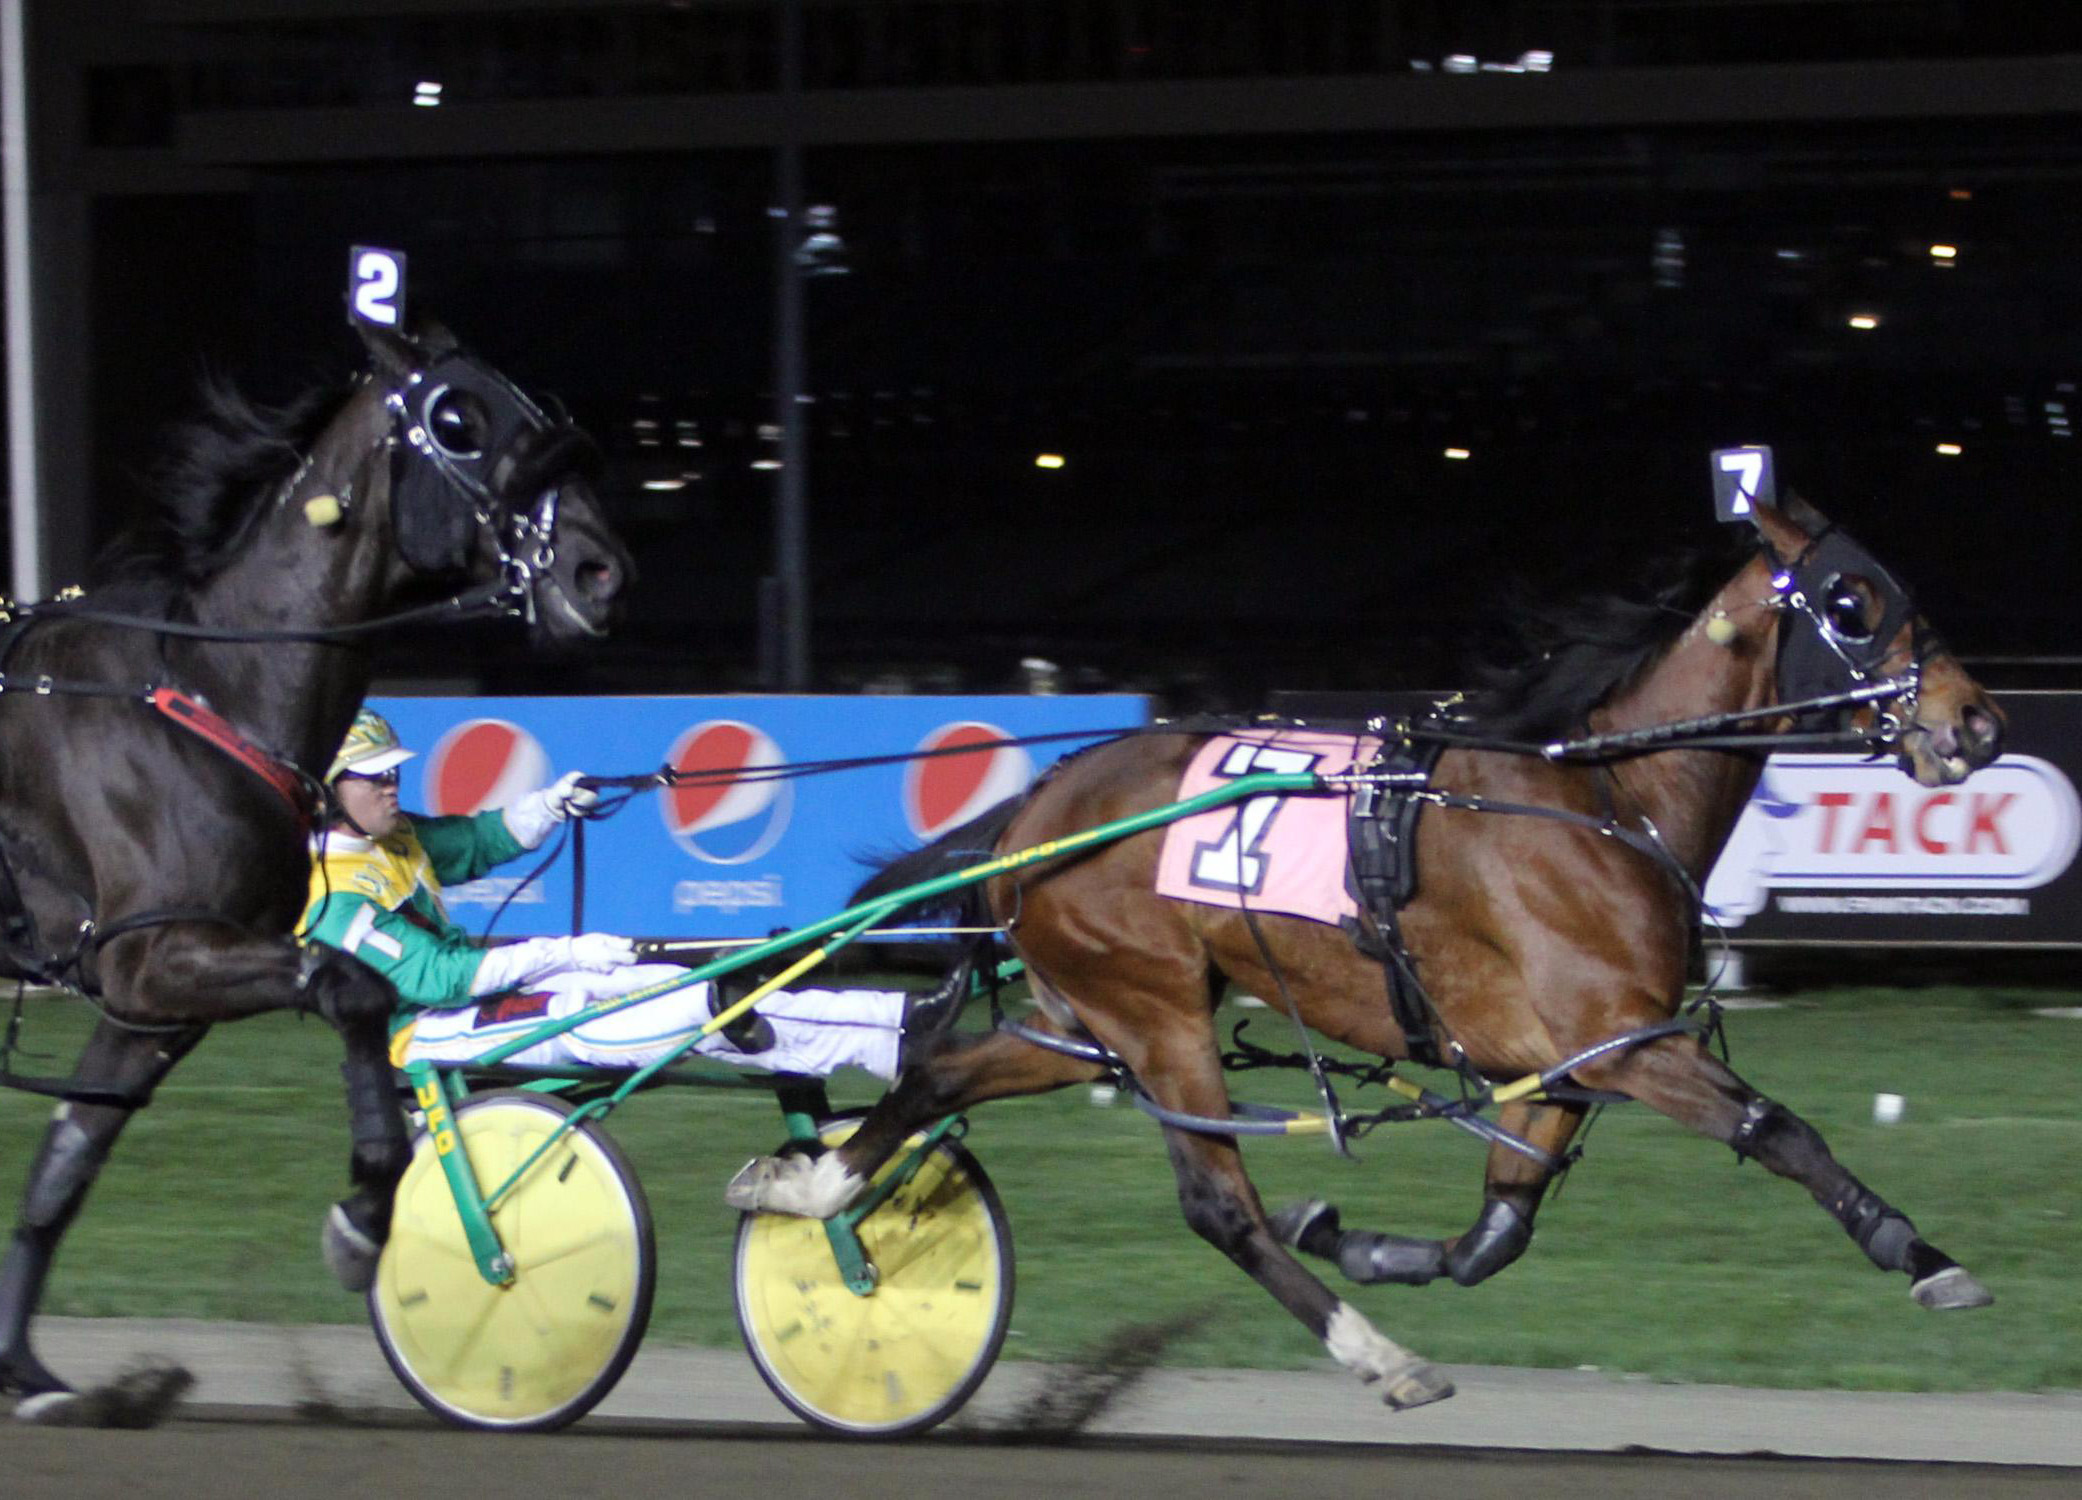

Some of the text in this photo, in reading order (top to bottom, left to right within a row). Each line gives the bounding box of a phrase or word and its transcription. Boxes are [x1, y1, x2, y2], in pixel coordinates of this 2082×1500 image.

[356, 252, 398, 324] 2
[1720, 453, 1762, 514] 7
[1189, 742, 1327, 895] 7
[1813, 792, 2019, 854] TACK
[673, 873, 784, 915] pepsi
[416, 1081, 455, 1157] UFO
